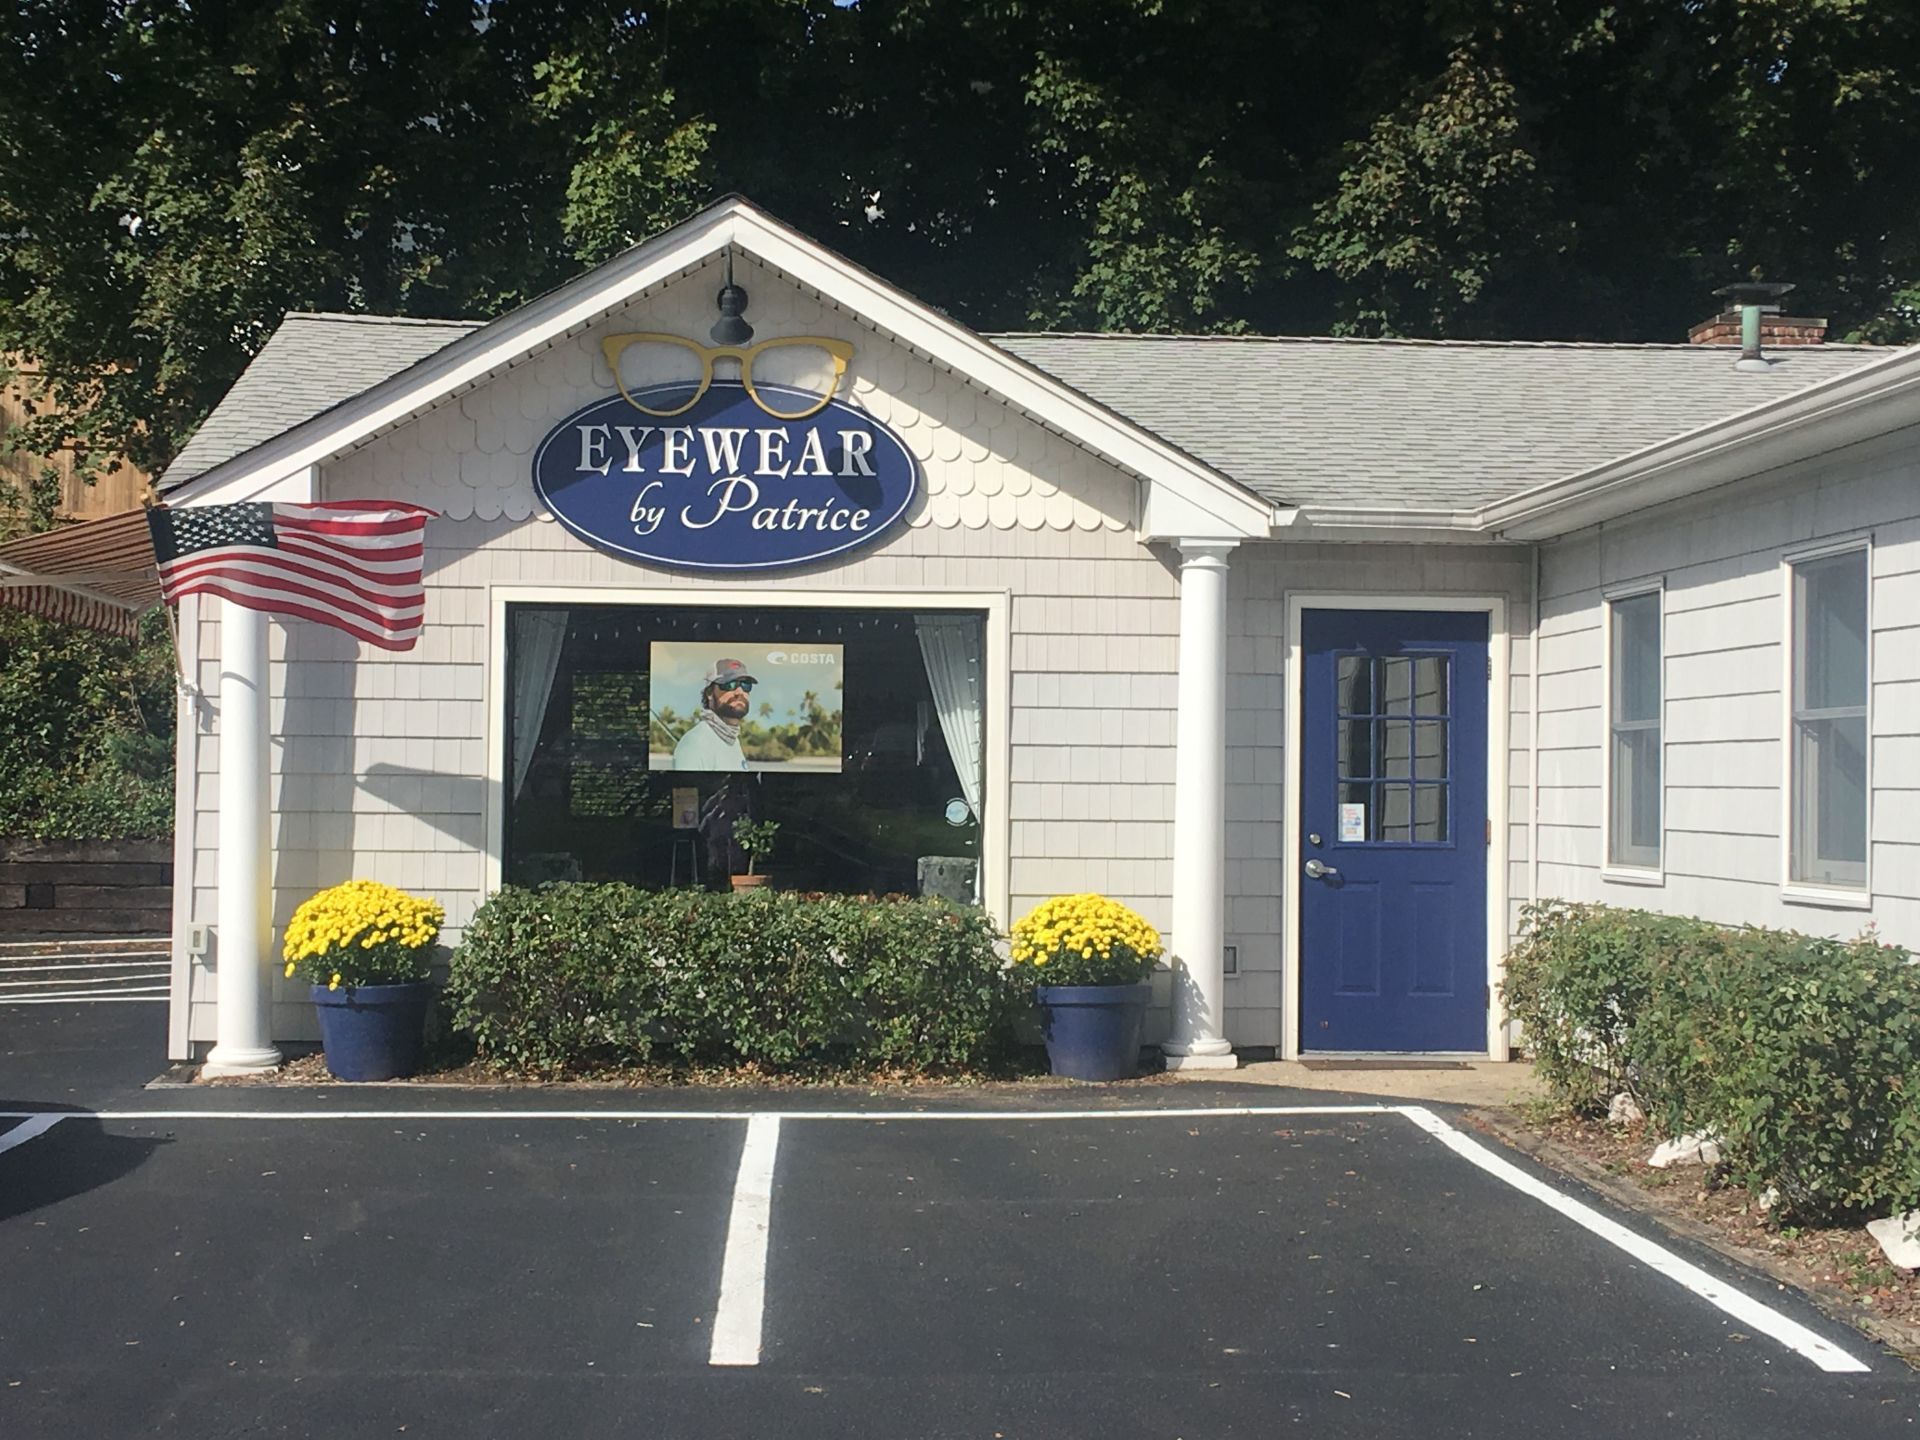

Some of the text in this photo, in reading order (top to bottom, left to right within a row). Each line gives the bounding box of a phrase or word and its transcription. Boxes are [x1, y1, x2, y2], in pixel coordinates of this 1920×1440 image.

[575, 423, 877, 479] EYEWEAR
[630, 474, 870, 535] by Patrice
[790, 653, 835, 664] COSTA
